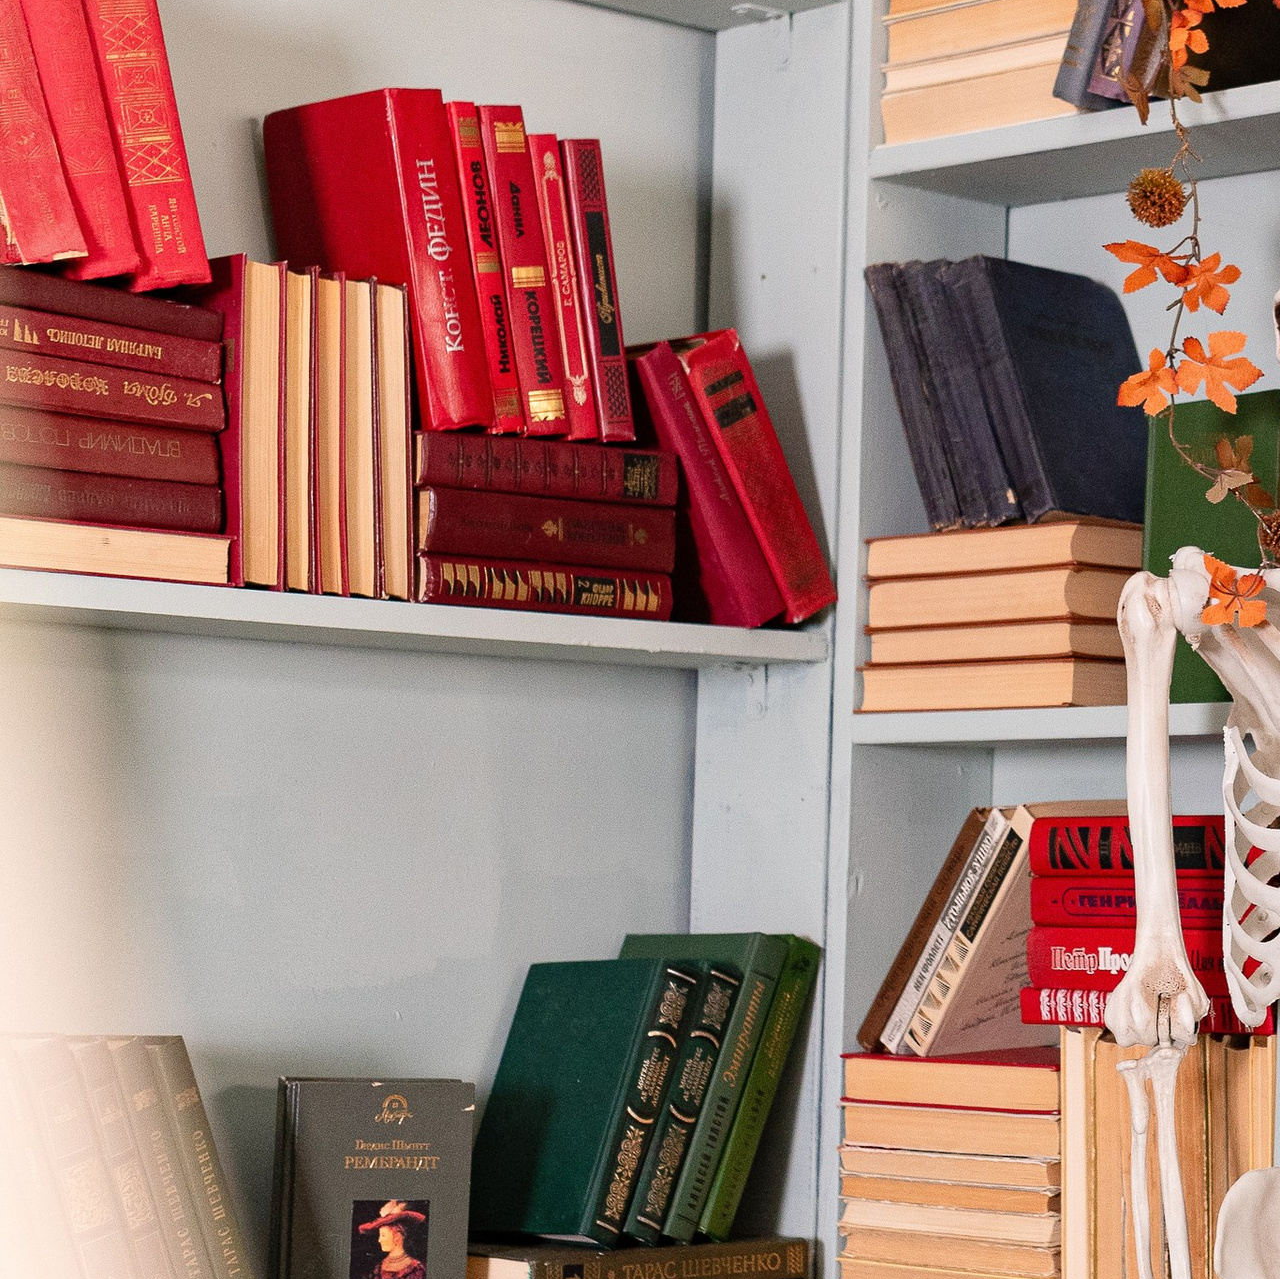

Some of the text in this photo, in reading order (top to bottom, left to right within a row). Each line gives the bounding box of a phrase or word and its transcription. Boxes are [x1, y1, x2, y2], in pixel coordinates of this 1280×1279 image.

[416, 158, 453, 262] ФЕДИН
[470, 160, 494, 249] ЛЕОНОВ
[46, 328, 163, 360] БАГРЯНАЯ ЛЕТОПИСЬ
[526, 290, 554, 384] КОРЕЦКИЙ
[78, 432, 181, 458] ВЛАДИМИР
[578, 577, 590, 588] 2
[580, 591, 614, 608] КНОРРЕ
[1078, 895, 1137, 908] ГЕНРИ
[722, 979, 766, 1089] Эмигранты
[706, 1095, 731, 1150] ТОЛСТОЙ
[344, 1155, 440, 1172] РЕМБРАНДТ
[150, 1128, 203, 1279] ТАРАС ШЕВЧЕНКО
[192, 1128, 241, 1278] ТАРАС ШЕВЧЕНКО
[682, 1252, 782, 1278] ШЕВЧЕНКО
